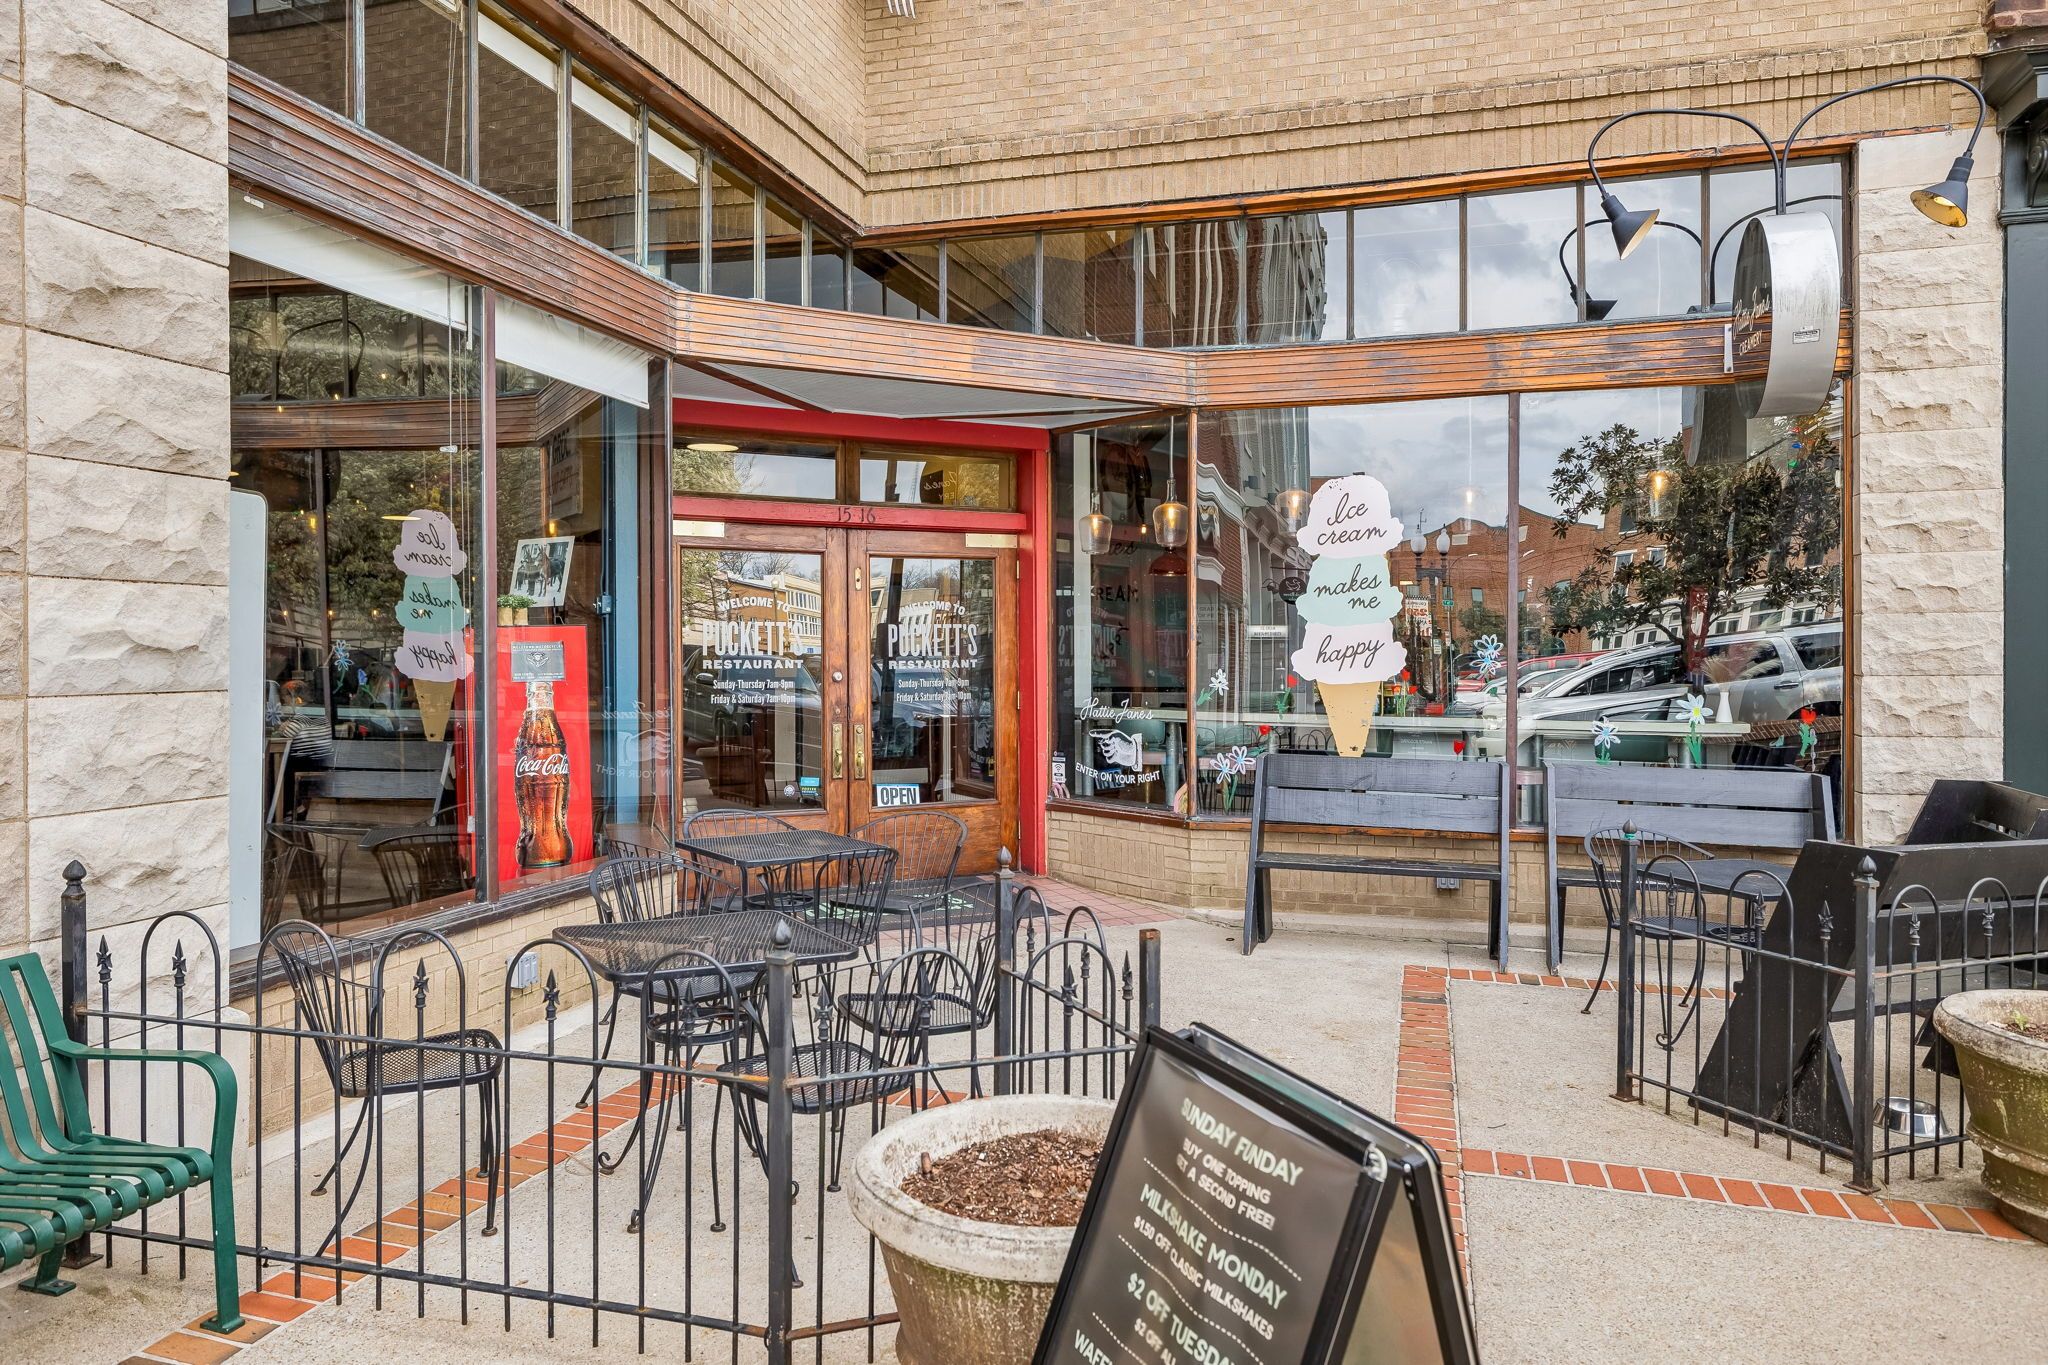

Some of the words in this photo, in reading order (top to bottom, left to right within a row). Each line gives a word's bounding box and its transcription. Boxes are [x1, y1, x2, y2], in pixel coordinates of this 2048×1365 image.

[1739, 329, 1763, 356] CREAMERY
[1327, 492, 1368, 526] Ice
[1317, 526, 1388, 546] cream
[1313, 563, 1382, 597] makes
[718, 596, 774, 612] WELCOME
[776, 600, 792, 613] TO
[901, 600, 952, 614] WELCOME
[952, 602, 966, 616] TO
[1347, 596, 1381, 609] me
[702, 620, 804, 657] PUCKETT'S
[888, 623, 979, 658] PUCKETT'S
[702, 659, 804, 670] RESTAURANT
[888, 659, 978, 670] RESTAURANT
[1315, 635, 1385, 671] happy
[713, 679, 766, 691] Sunday-Thursday
[766, 679, 795, 691] 7am-9pm
[896, 693, 914, 704] Friday
[919, 692, 944, 703] Saturday
[898, 679, 944, 690] Sunday-Thursday
[710, 694, 731, 705] Friday
[731, 694, 738, 704] &
[738, 694, 765, 705] Saturday
[766, 694, 797, 704] 7am-10pm
[1080, 697, 1116, 721] Hattie
[1115, 698, 1154, 724] Jane's
[515, 753, 570, 778] Coca-Cola
[1075, 762, 1099, 779] ENTER
[1100, 771, 1114, 781] ON
[1114, 773, 1137, 784] YOUR
[1137, 771, 1161, 784] RIGHT
[880, 786, 917, 805] OPEN
[1181, 1097, 1237, 1148] SUNDAY
[1234, 1136, 1304, 1186] FUNDAY
[1183, 1137, 1203, 1160] BUY
[1203, 1153, 1227, 1178] ONE
[1224, 1167, 1272, 1204] TOPPING
[1176, 1153, 1189, 1173] GET
[1187, 1166, 1197, 1182] A
[1198, 1174, 1236, 1210] SECOND
[1237, 1200, 1276, 1231] FREE!
[1140, 1183, 1207, 1257] MILKSHAKE
[1207, 1243, 1287, 1310] MONDAY
[1154, 1232, 1172, 1254] OFF
[1170, 1248, 1203, 1287] CLASSIC
[1203, 1279, 1274, 1340] MILKSHAKES
[1127, 1272, 1146, 1301] $2
[1145, 1289, 1171, 1323] OFF
[1169, 1313, 1236, 1365] TUESD
[1134, 1317, 1147, 1336] $2
[1145, 1329, 1164, 1352] OFF
